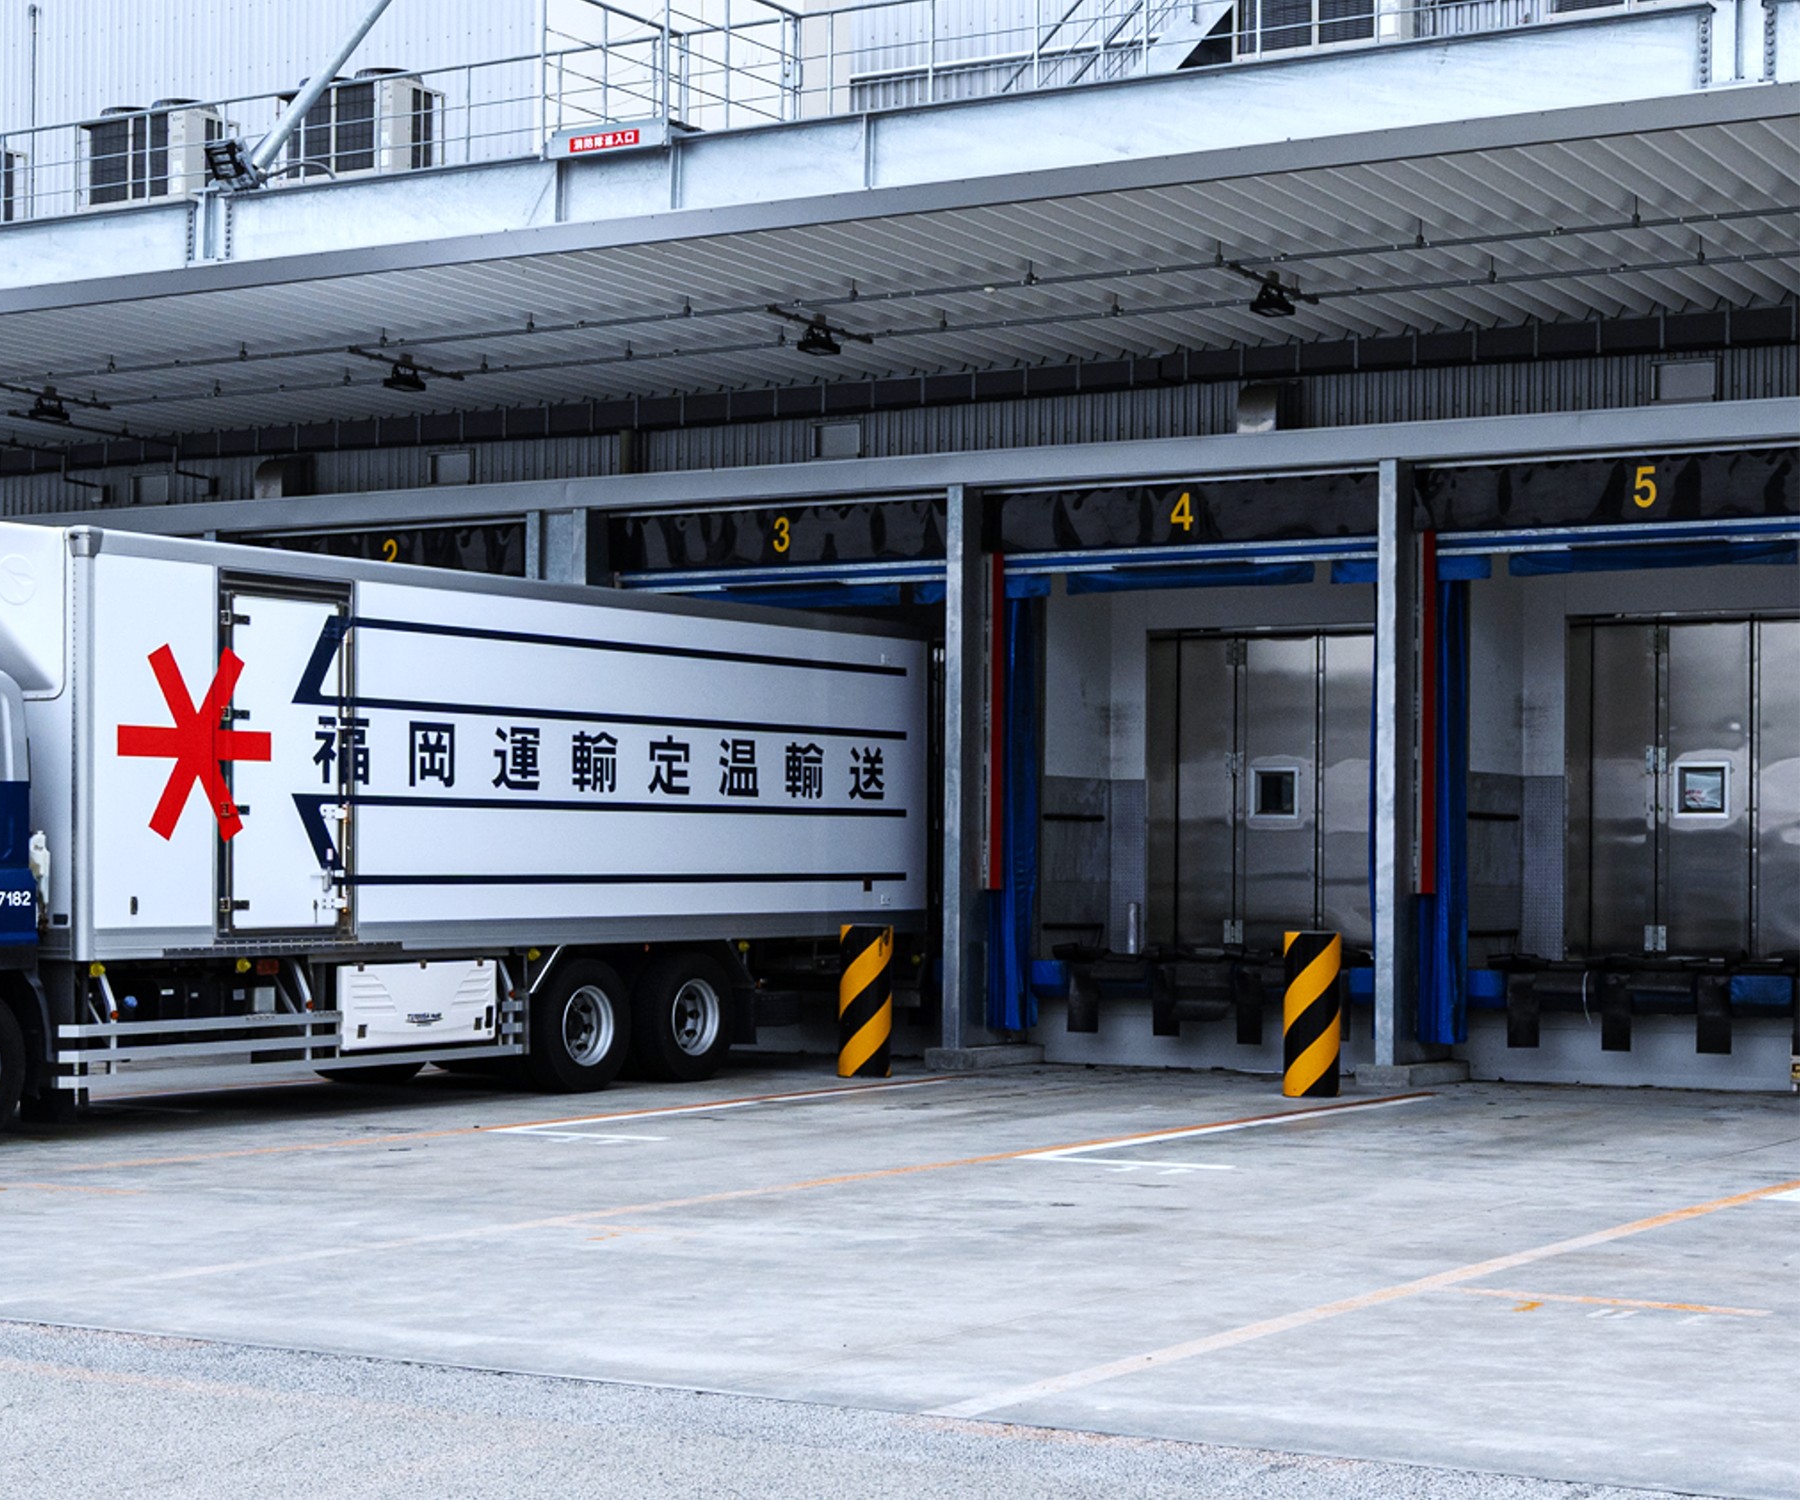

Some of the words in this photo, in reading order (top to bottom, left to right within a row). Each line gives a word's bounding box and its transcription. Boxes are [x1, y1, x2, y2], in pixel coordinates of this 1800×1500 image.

[1632, 466, 1658, 509] 5
[1169, 492, 1195, 532] 4
[382, 538, 399, 562] 2
[773, 516, 791, 553] 3
[313, 715, 886, 800] 福岡運輸定温輸送
